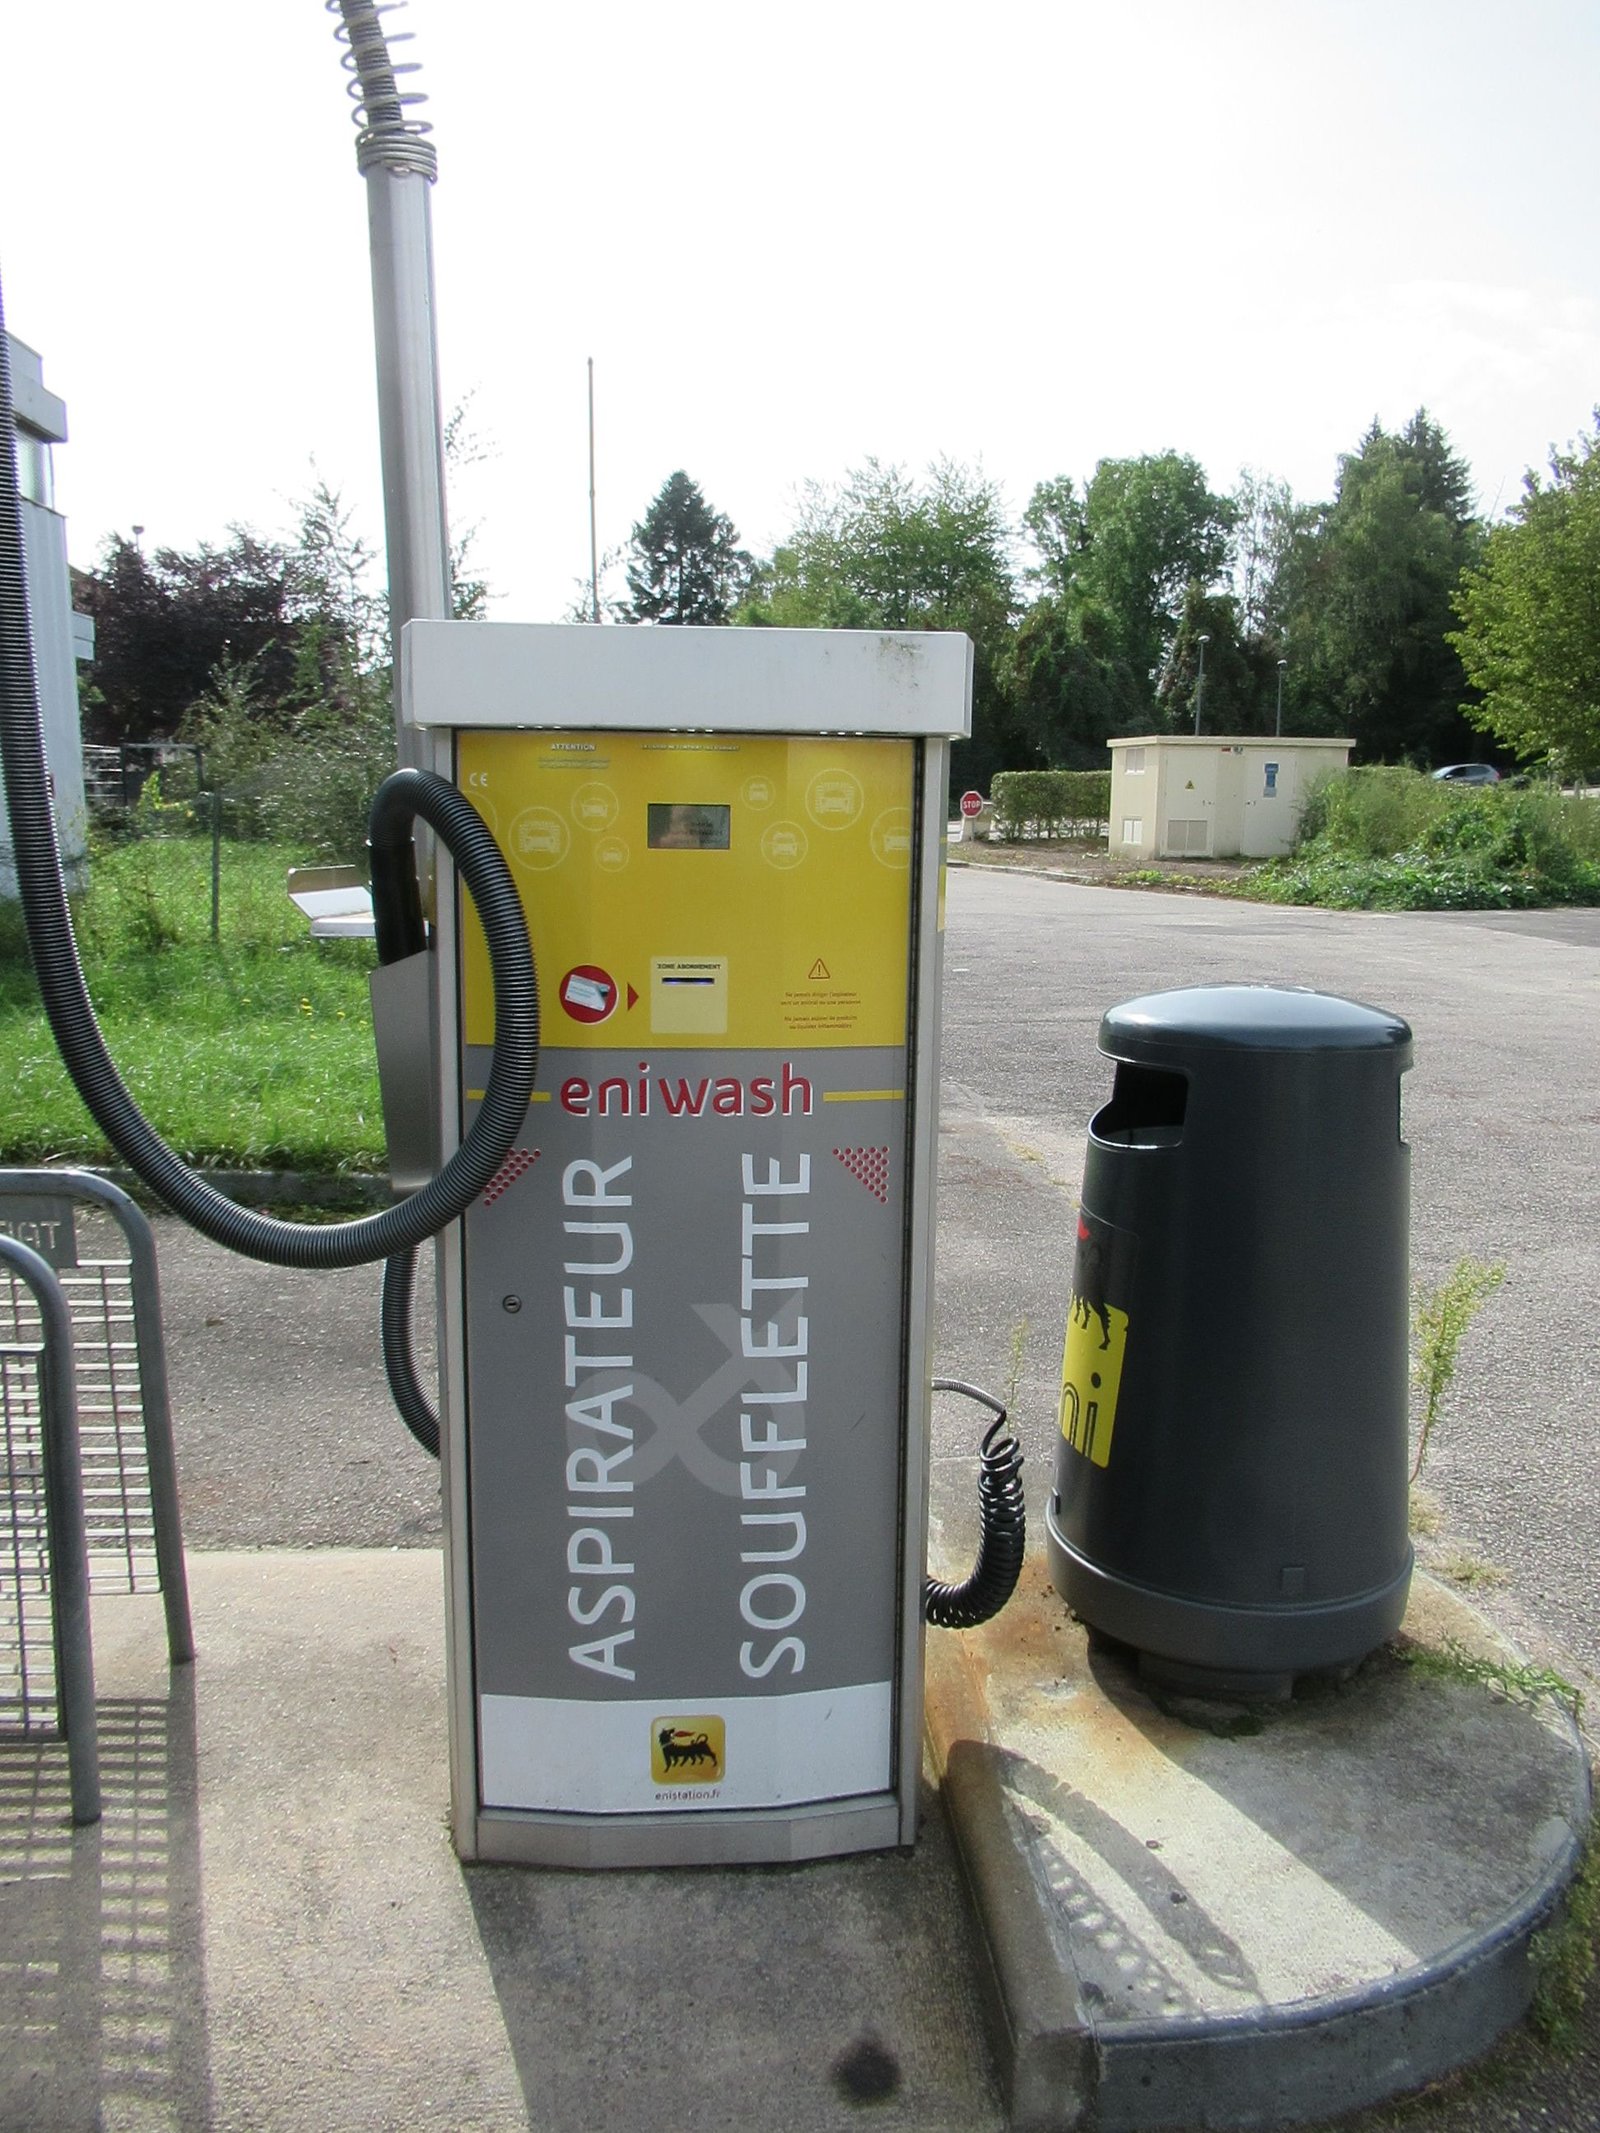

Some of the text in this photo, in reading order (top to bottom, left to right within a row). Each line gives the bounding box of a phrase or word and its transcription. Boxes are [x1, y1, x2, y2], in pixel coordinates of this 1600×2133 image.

[551, 743, 596, 751] ATTENTION
[963, 800, 981, 809] STOP
[562, 1155, 636, 1681] ASPIRATEUR
[739, 1152, 811, 1678] SOUFFLETTE
[655, 1788, 721, 1801] enistation.fr
